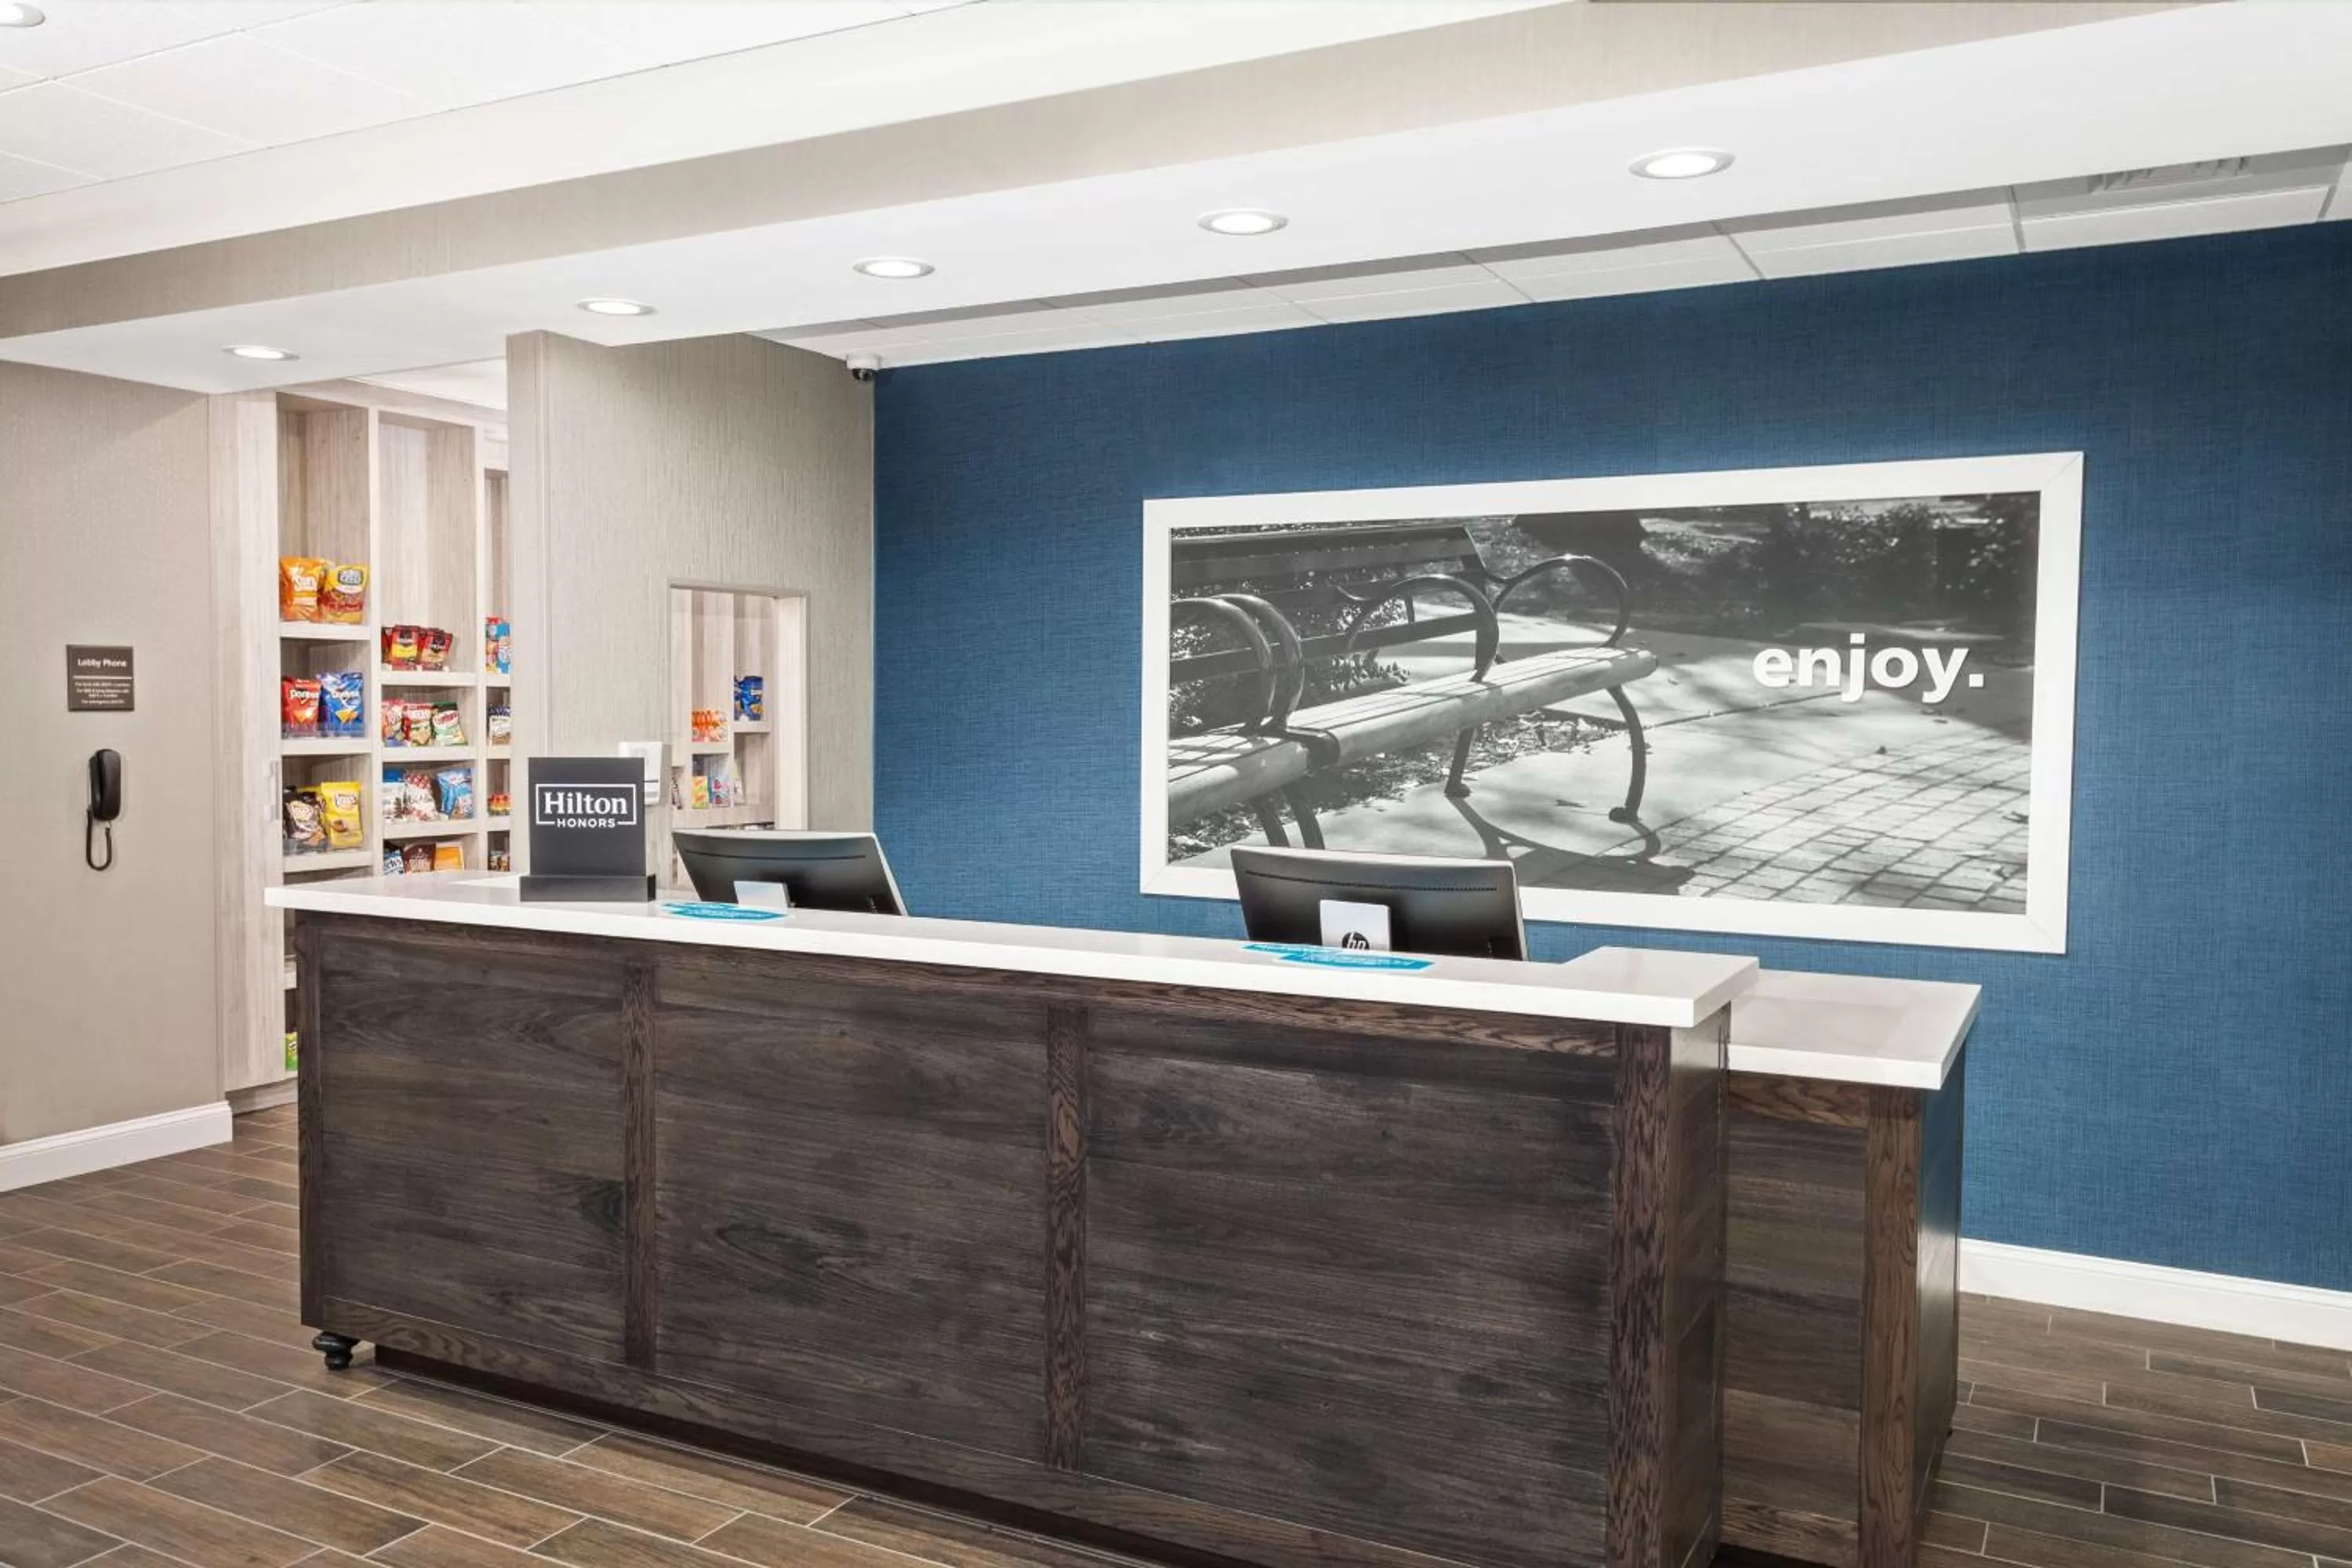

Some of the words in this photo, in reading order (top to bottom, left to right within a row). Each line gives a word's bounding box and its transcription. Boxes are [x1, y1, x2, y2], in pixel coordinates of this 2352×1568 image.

[78, 658, 101, 669] Lobby
[103, 659, 127, 667] Phone
[1752, 633, 1985, 703] enjoy.
[543, 791, 628, 815] Hilton
[557, 818, 615, 828] HONORS
